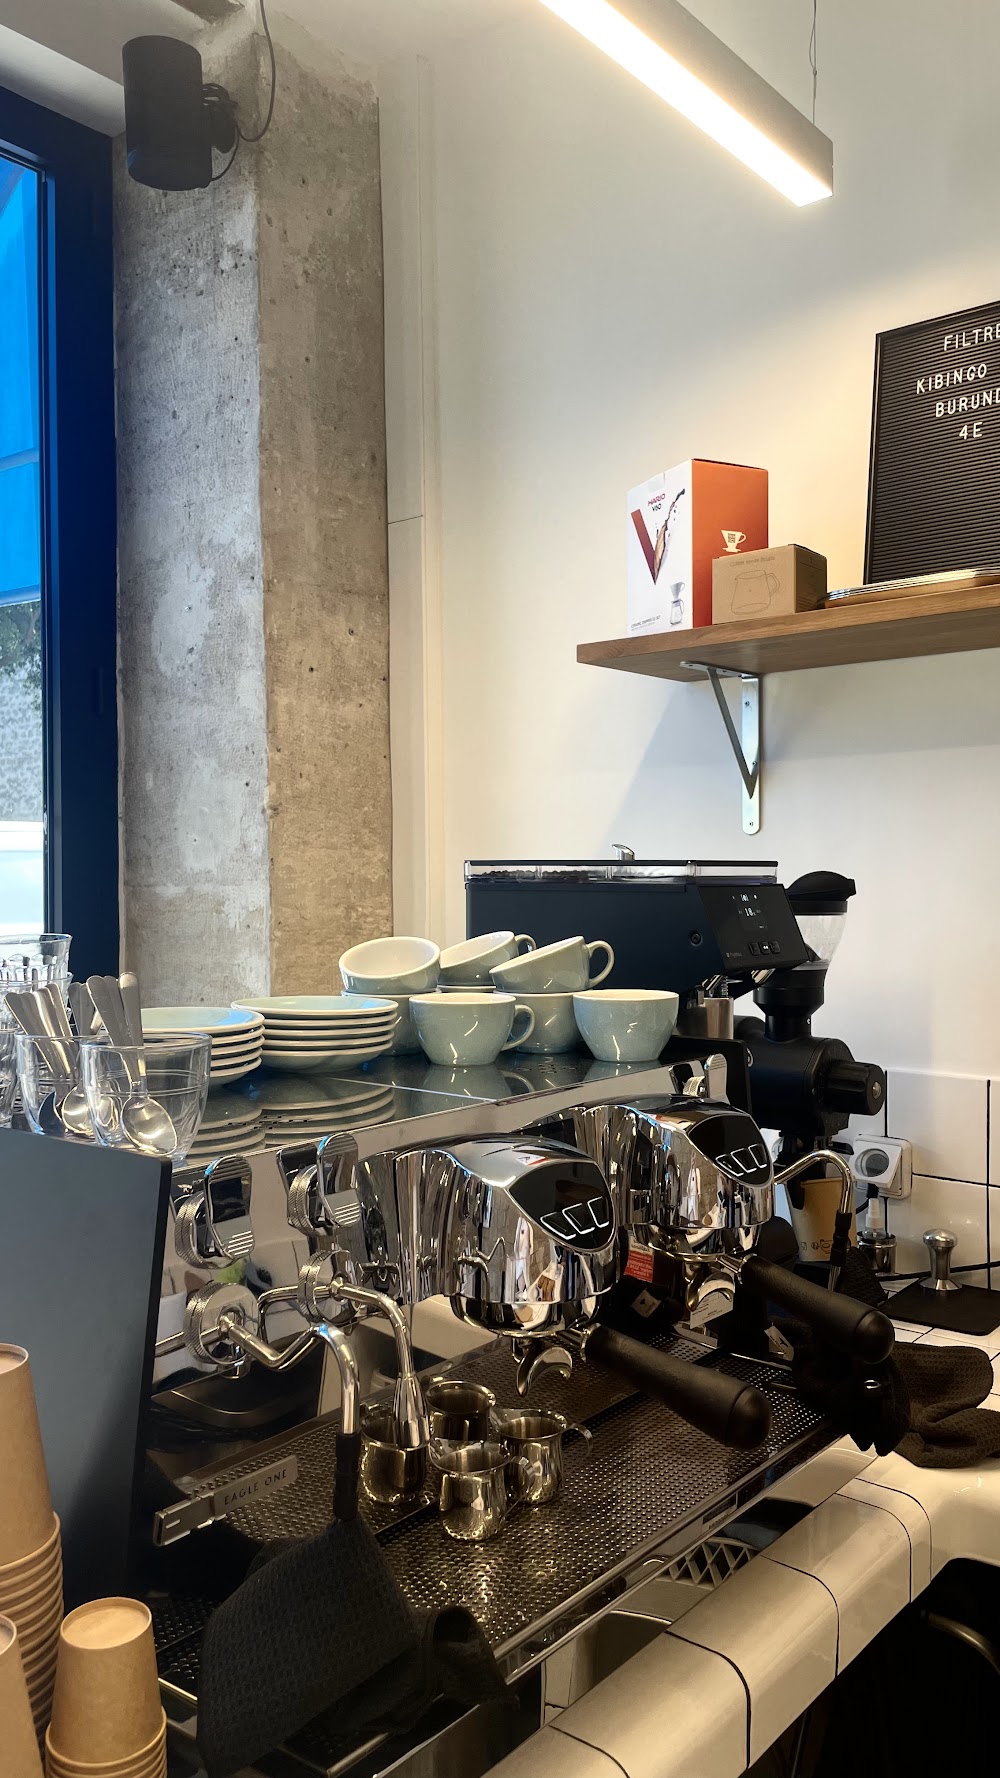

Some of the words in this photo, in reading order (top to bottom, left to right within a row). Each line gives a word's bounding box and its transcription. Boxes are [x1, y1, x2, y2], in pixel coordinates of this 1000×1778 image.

[916, 363, 988, 394] KIBINGO
[224, 1482, 259, 1506] EAGLE
[264, 1469, 287, 1486] ONE
